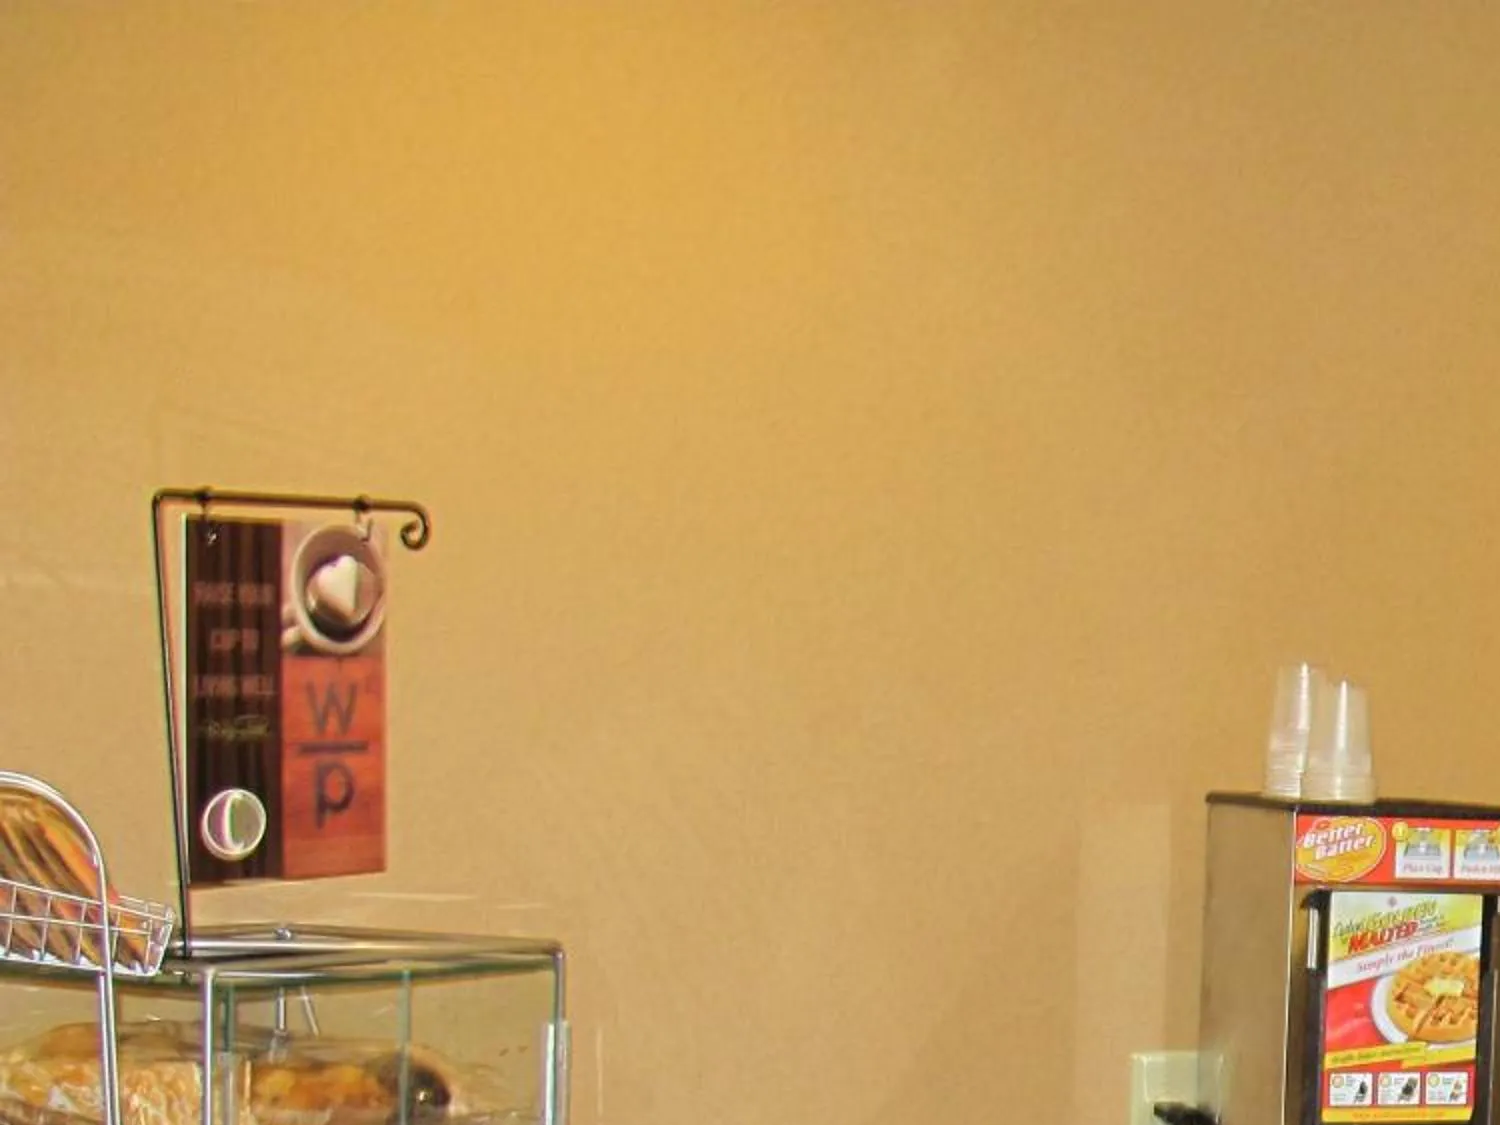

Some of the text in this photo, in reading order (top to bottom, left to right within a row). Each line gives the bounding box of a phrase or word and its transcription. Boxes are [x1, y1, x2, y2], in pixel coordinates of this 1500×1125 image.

[307, 680, 359, 737] W
[1303, 822, 1365, 849] Better
[1315, 834, 1376, 860] Batter
